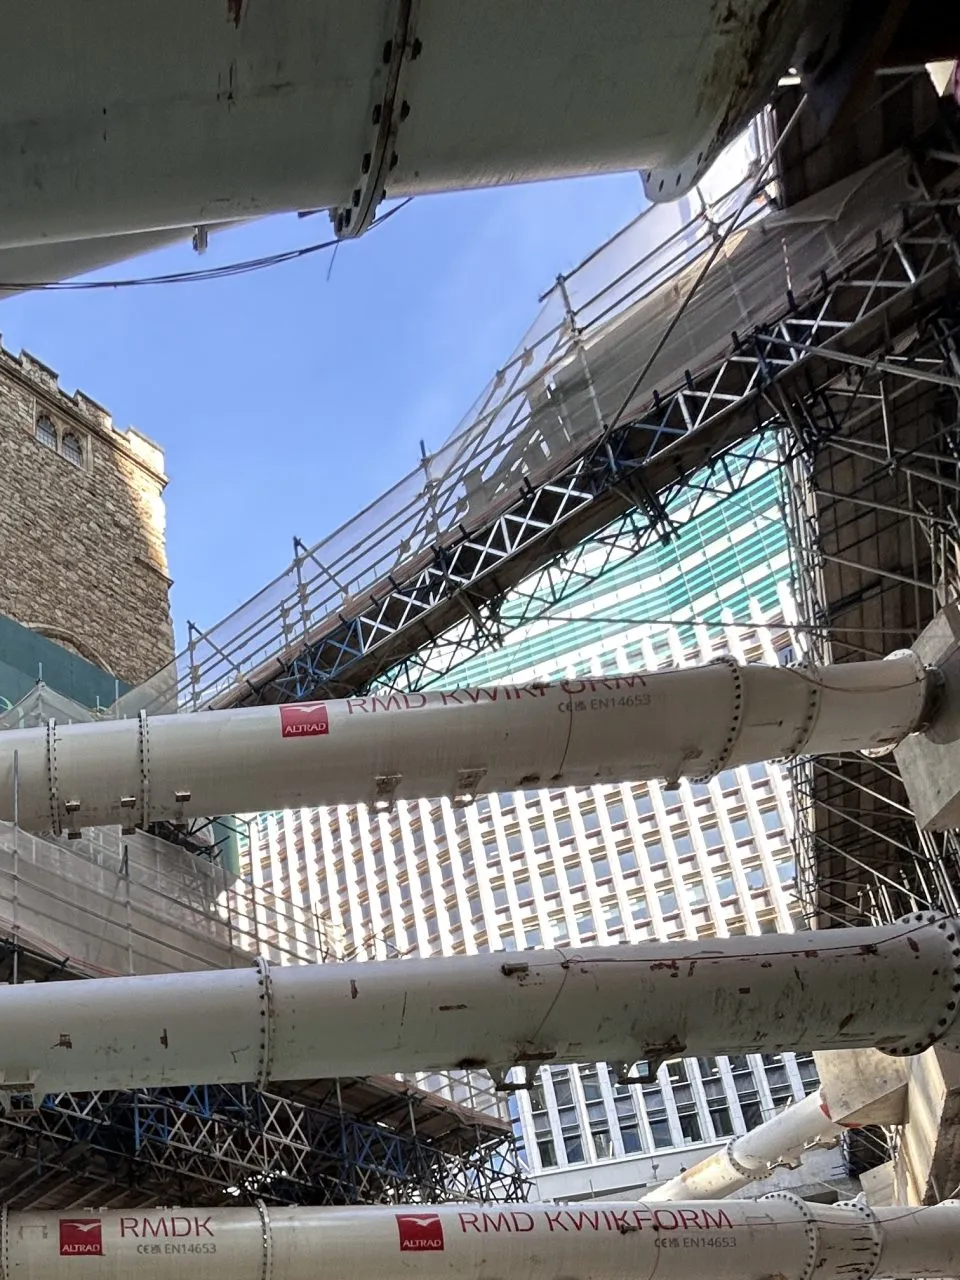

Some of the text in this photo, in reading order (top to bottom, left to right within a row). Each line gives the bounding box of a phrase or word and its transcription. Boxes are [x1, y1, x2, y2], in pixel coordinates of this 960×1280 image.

[348, 692, 428, 716] RMD
[285, 721, 327, 734] ALTRAD
[120, 1216, 215, 1238] RMDK
[458, 1209, 733, 1233] RMD KWIKFORM
[62, 1243, 101, 1253] ALTRAD
[165, 1243, 217, 1255] EN14653
[402, 1238, 442, 1249] ALTRAD
[683, 1236, 737, 1249] EN14653
